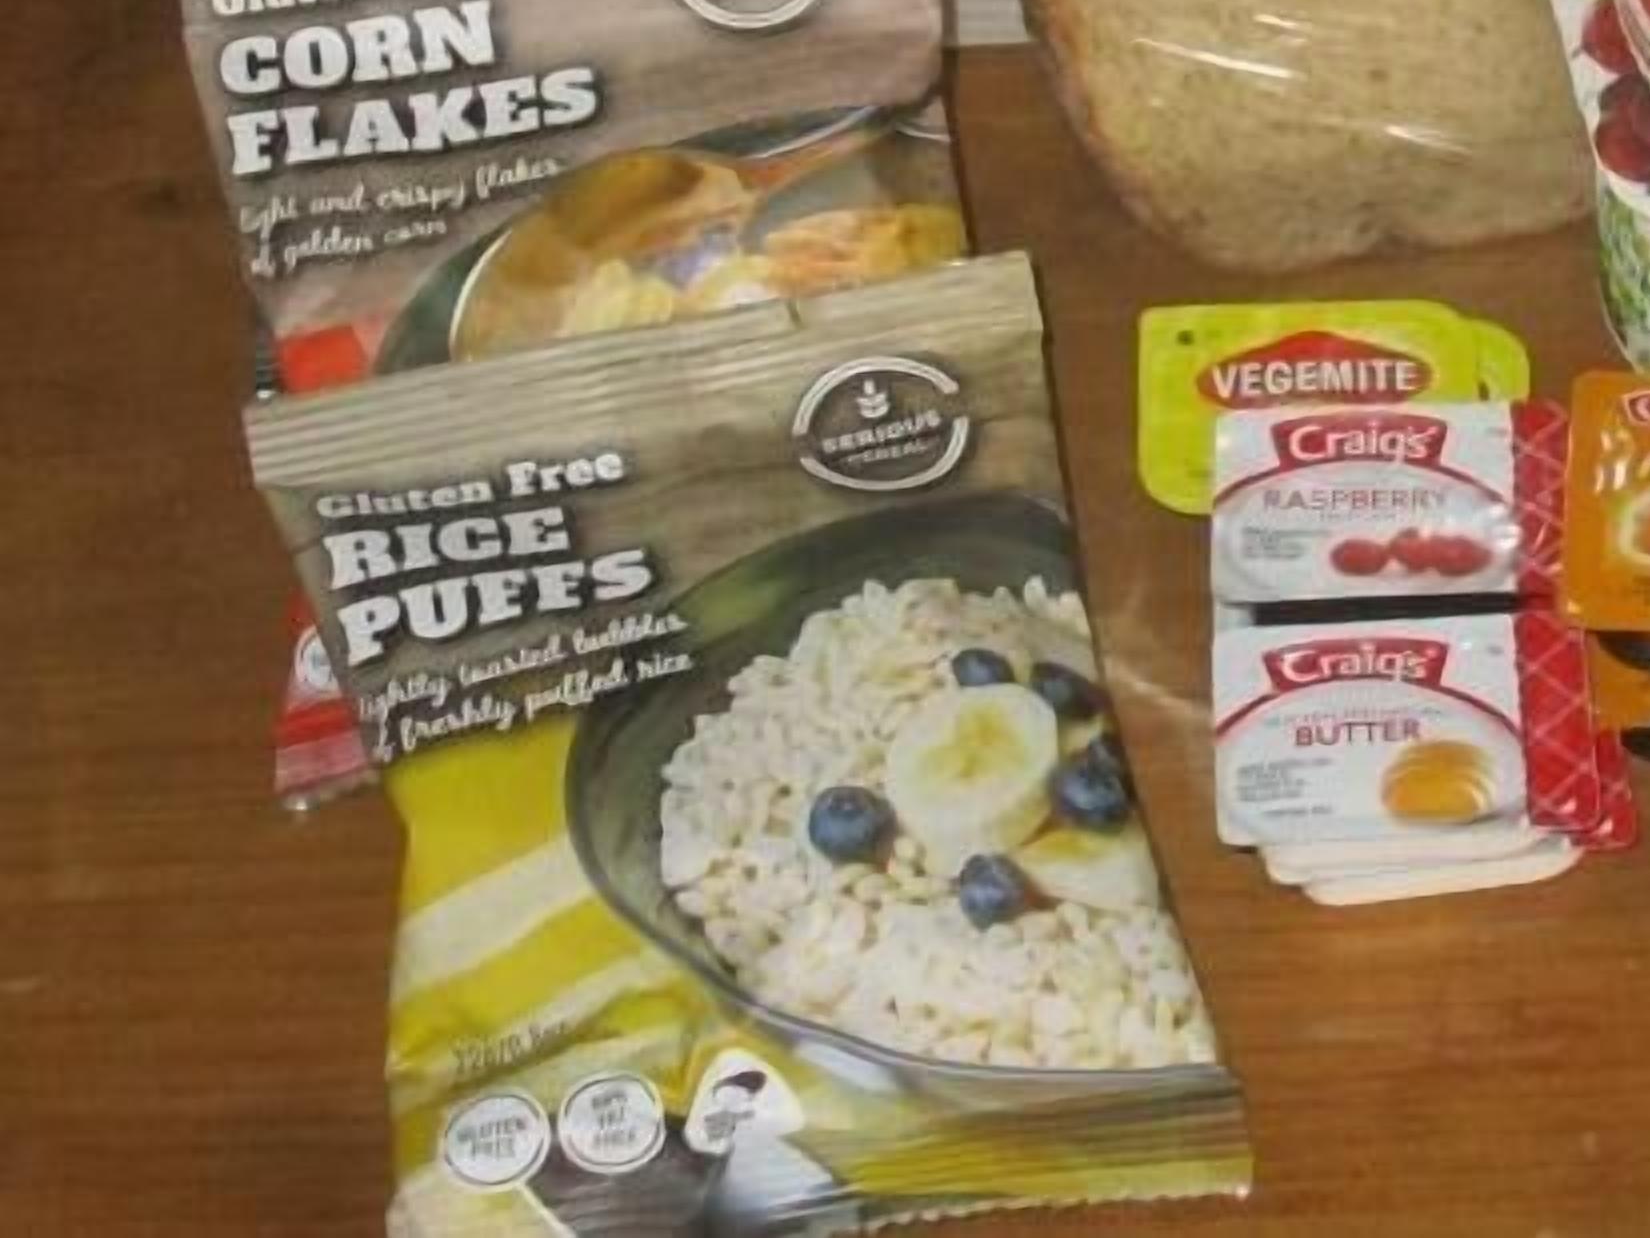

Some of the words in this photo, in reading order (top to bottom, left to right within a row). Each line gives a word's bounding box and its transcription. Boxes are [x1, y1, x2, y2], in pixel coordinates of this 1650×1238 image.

[220, 0, 495, 94] CORN
[227, 67, 597, 177] FLAKES
[310, 180, 367, 213] and
[476, 157, 560, 199] flakes
[1212, 359, 1418, 399] VEGEMITE
[316, 480, 495, 519] Gluten
[507, 452, 625, 496] Free
[1263, 489, 1447, 511] RASPBERRY
[323, 506, 570, 590] RICE
[337, 549, 652, 666] PUFFS
[1295, 718, 1421, 747] BUTTER
